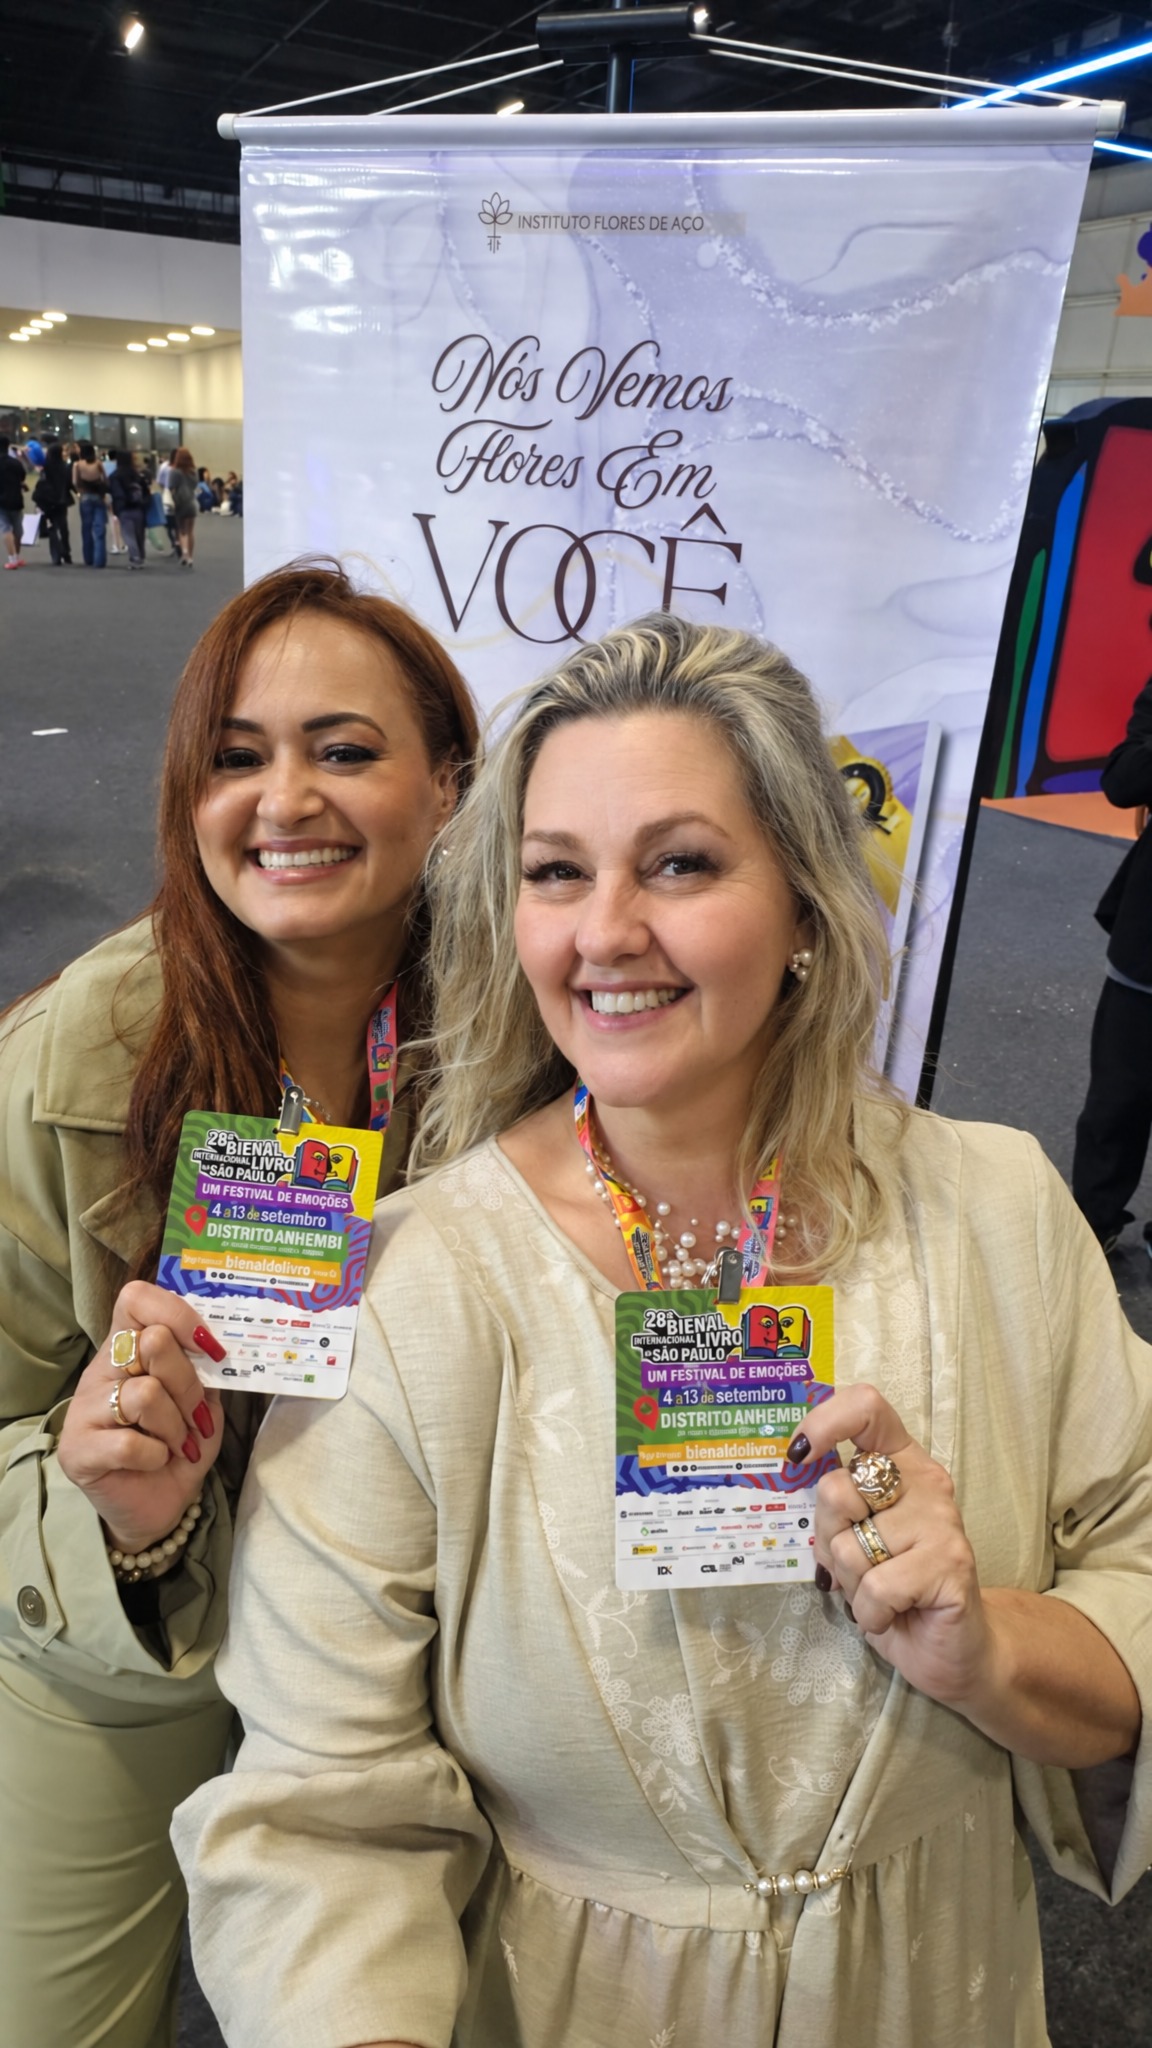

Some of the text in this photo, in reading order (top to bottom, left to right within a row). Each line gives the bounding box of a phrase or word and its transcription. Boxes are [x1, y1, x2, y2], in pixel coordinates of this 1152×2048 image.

[518, 215, 704, 234] INSTITUTO FLORES DE AÇO
[431, 334, 734, 421] Nós Vemos
[436, 419, 717, 510] Flores Em
[412, 502, 743, 645] VOCÊ
[226, 1141, 282, 1157] BIENAL
[251, 1157, 295, 1173] LIVRO
[236, 1169, 276, 1184] PAULO
[202, 1183, 349, 1210] UM FESTIVAL DE EMOÇÕES
[212, 1203, 222, 1217] 4
[232, 1205, 246, 1219] 13
[261, 1211, 327, 1228] setembro
[207, 1223, 274, 1243] DISTRITO
[274, 1230, 343, 1250] ANHEMBI
[225, 1255, 311, 1276] bienaldolivro
[667, 1313, 728, 1335] BIENAL
[634, 1330, 742, 1348] INTERNACIONAL LIVRO
[652, 1346, 678, 1362] SÃO
[681, 1347, 725, 1362] PAULO
[648, 1362, 807, 1382] UM FESTIVAL DE EMOÇÕES
[663, 1386, 786, 1405] 4 a 13 de setembro
[661, 1407, 808, 1428] DISTRITO ANHEMBI
[686, 1443, 777, 1460] bienaldolivro
